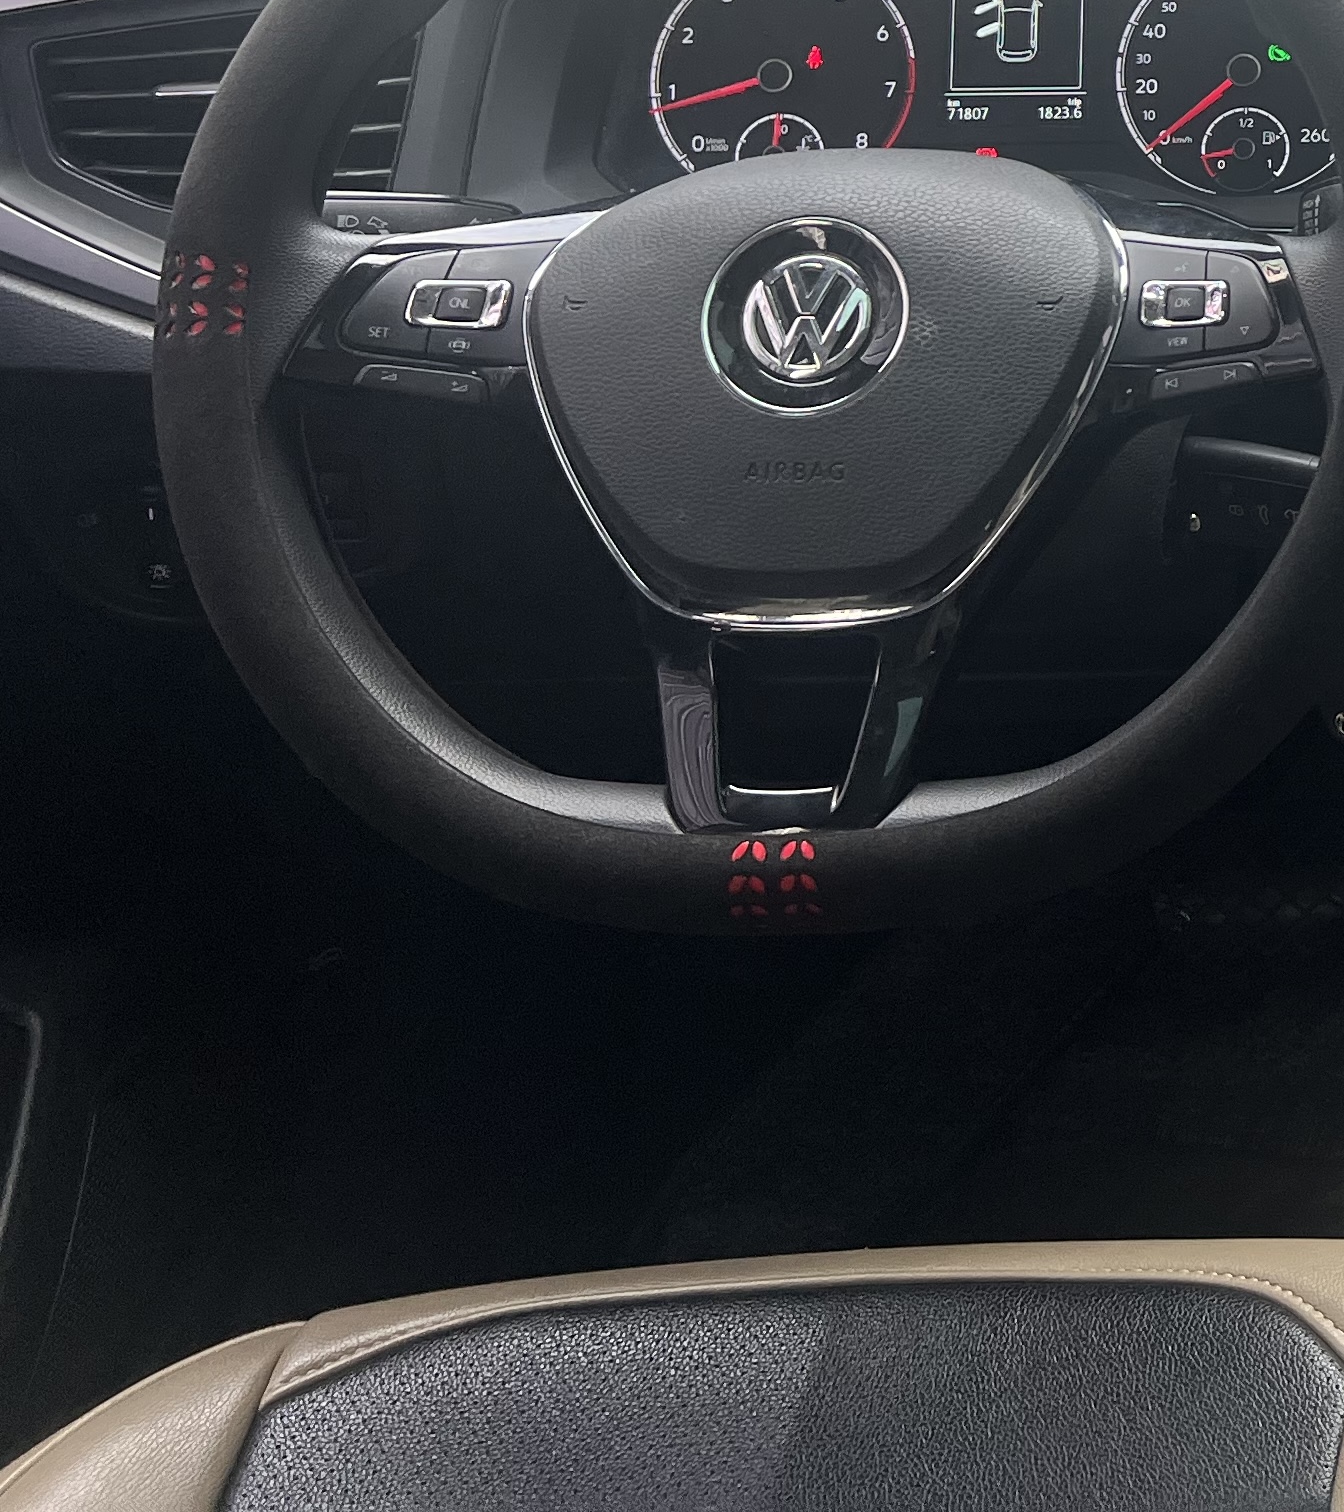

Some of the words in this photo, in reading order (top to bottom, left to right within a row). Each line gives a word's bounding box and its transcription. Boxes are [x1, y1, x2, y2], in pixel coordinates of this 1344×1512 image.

[1161, 2, 1177, 13] 50
[682, 28, 694, 44] 2
[877, 25, 889, 41] 6
[1142, 23, 1167, 39] 40
[1135, 53, 1152, 65] 30
[669, 84, 676, 100] 1
[884, 82, 896, 97] 7
[1135, 79, 1158, 94] 20
[947, 107, 989, 120] 71807
[1038, 106, 1083, 119] 1823.6
[1143, 110, 1156, 121] 10
[1239, 118, 1254, 128] 1/2
[692, 135, 704, 152] 0
[855, 133, 868, 149] 8
[1217, 160, 1226, 169] 0
[1266, 159, 1272, 169] 1
[449, 297, 470, 309] CNL
[1174, 296, 1191, 308] OK
[368, 326, 389, 338] SET
[1168, 337, 1188, 346] VIEW
[744, 461, 846, 482] AIRBAG
